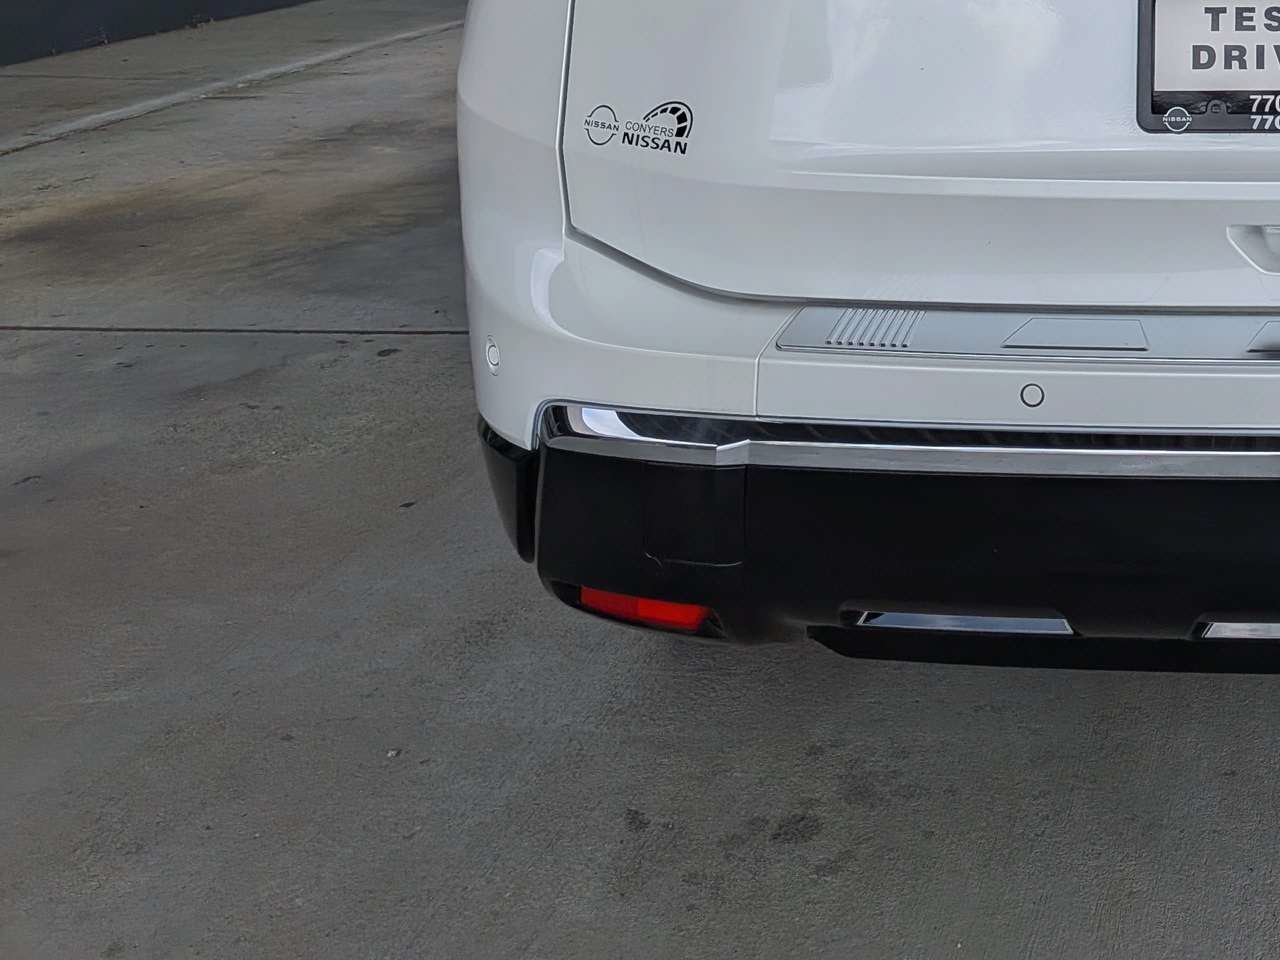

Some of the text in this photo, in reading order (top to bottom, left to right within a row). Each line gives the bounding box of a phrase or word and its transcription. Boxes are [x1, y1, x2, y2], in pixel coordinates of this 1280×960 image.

[584, 119, 620, 132] NISSAN
[624, 120, 675, 138] CONYERS
[621, 131, 688, 155] NISSAN
